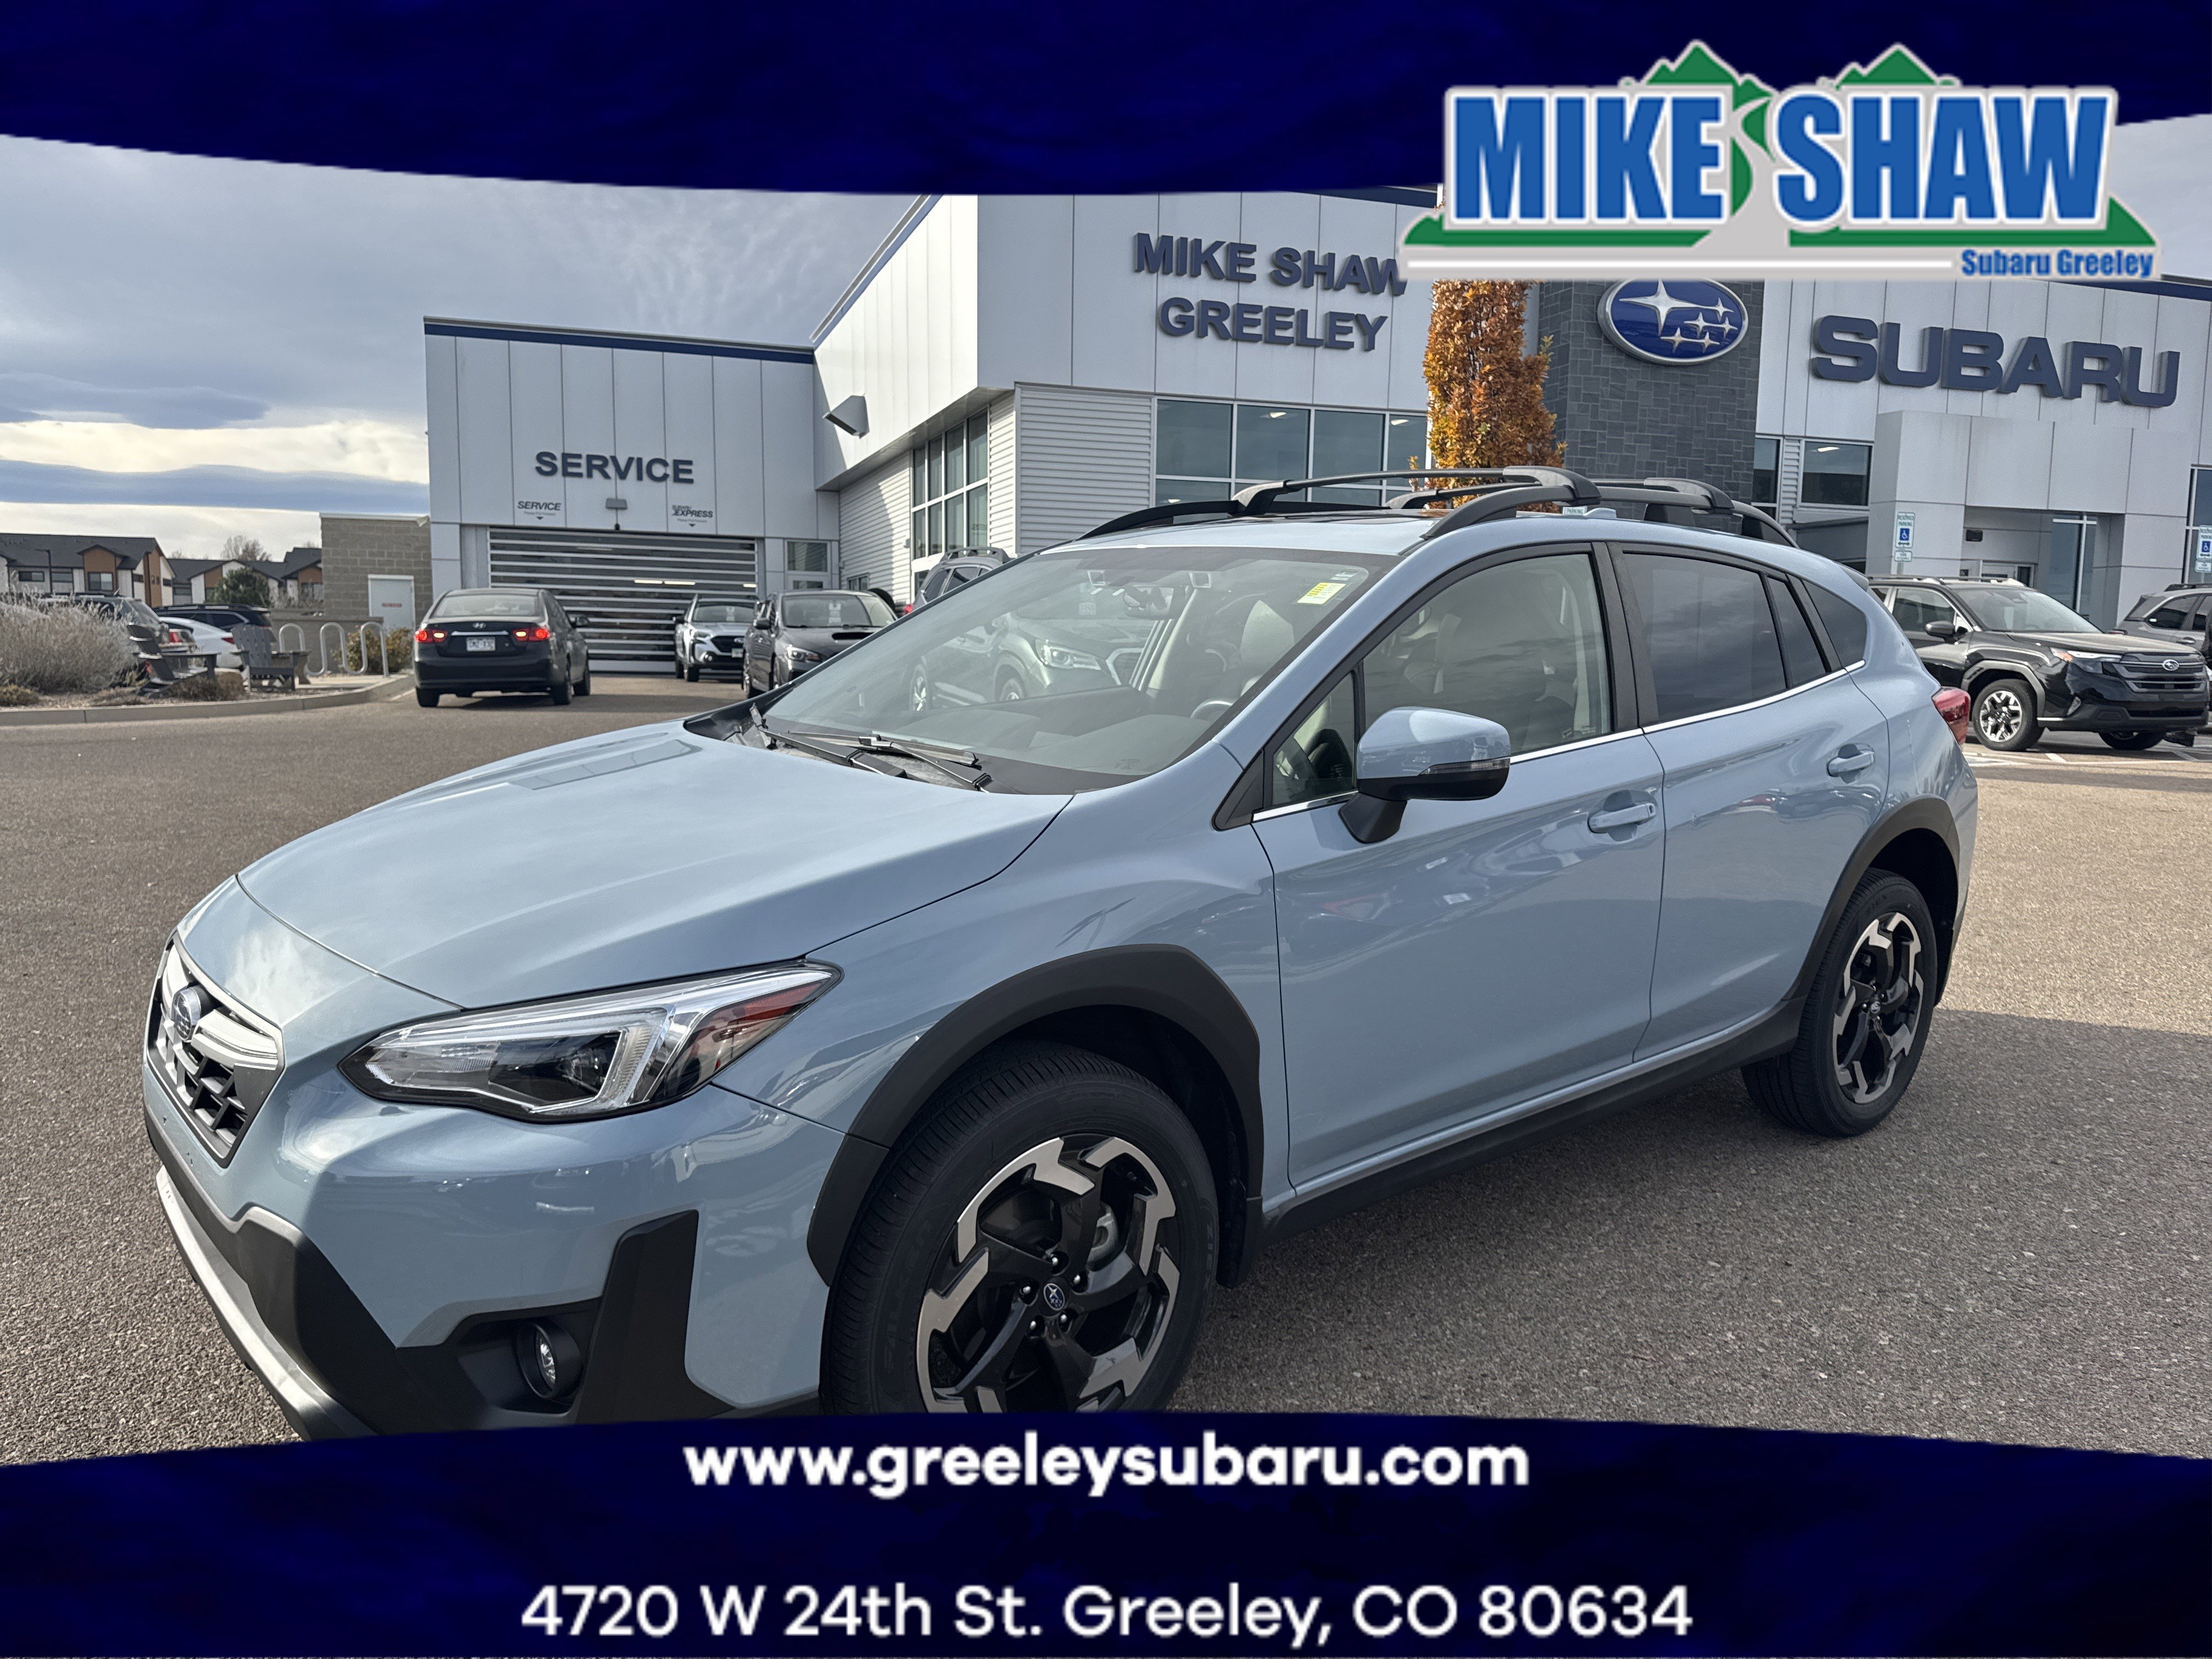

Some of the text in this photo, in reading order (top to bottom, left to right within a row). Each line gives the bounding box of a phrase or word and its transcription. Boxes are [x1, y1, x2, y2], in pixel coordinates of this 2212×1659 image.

[1134, 233, 1408, 297] MIKE SHAW
[1159, 297, 1388, 352] GREELEY
[1810, 315, 2180, 408] SUBARU
[535, 451, 695, 484] SERVICE
[517, 500, 562, 511] SERVICE
[673, 510, 713, 518] EXPRESS
